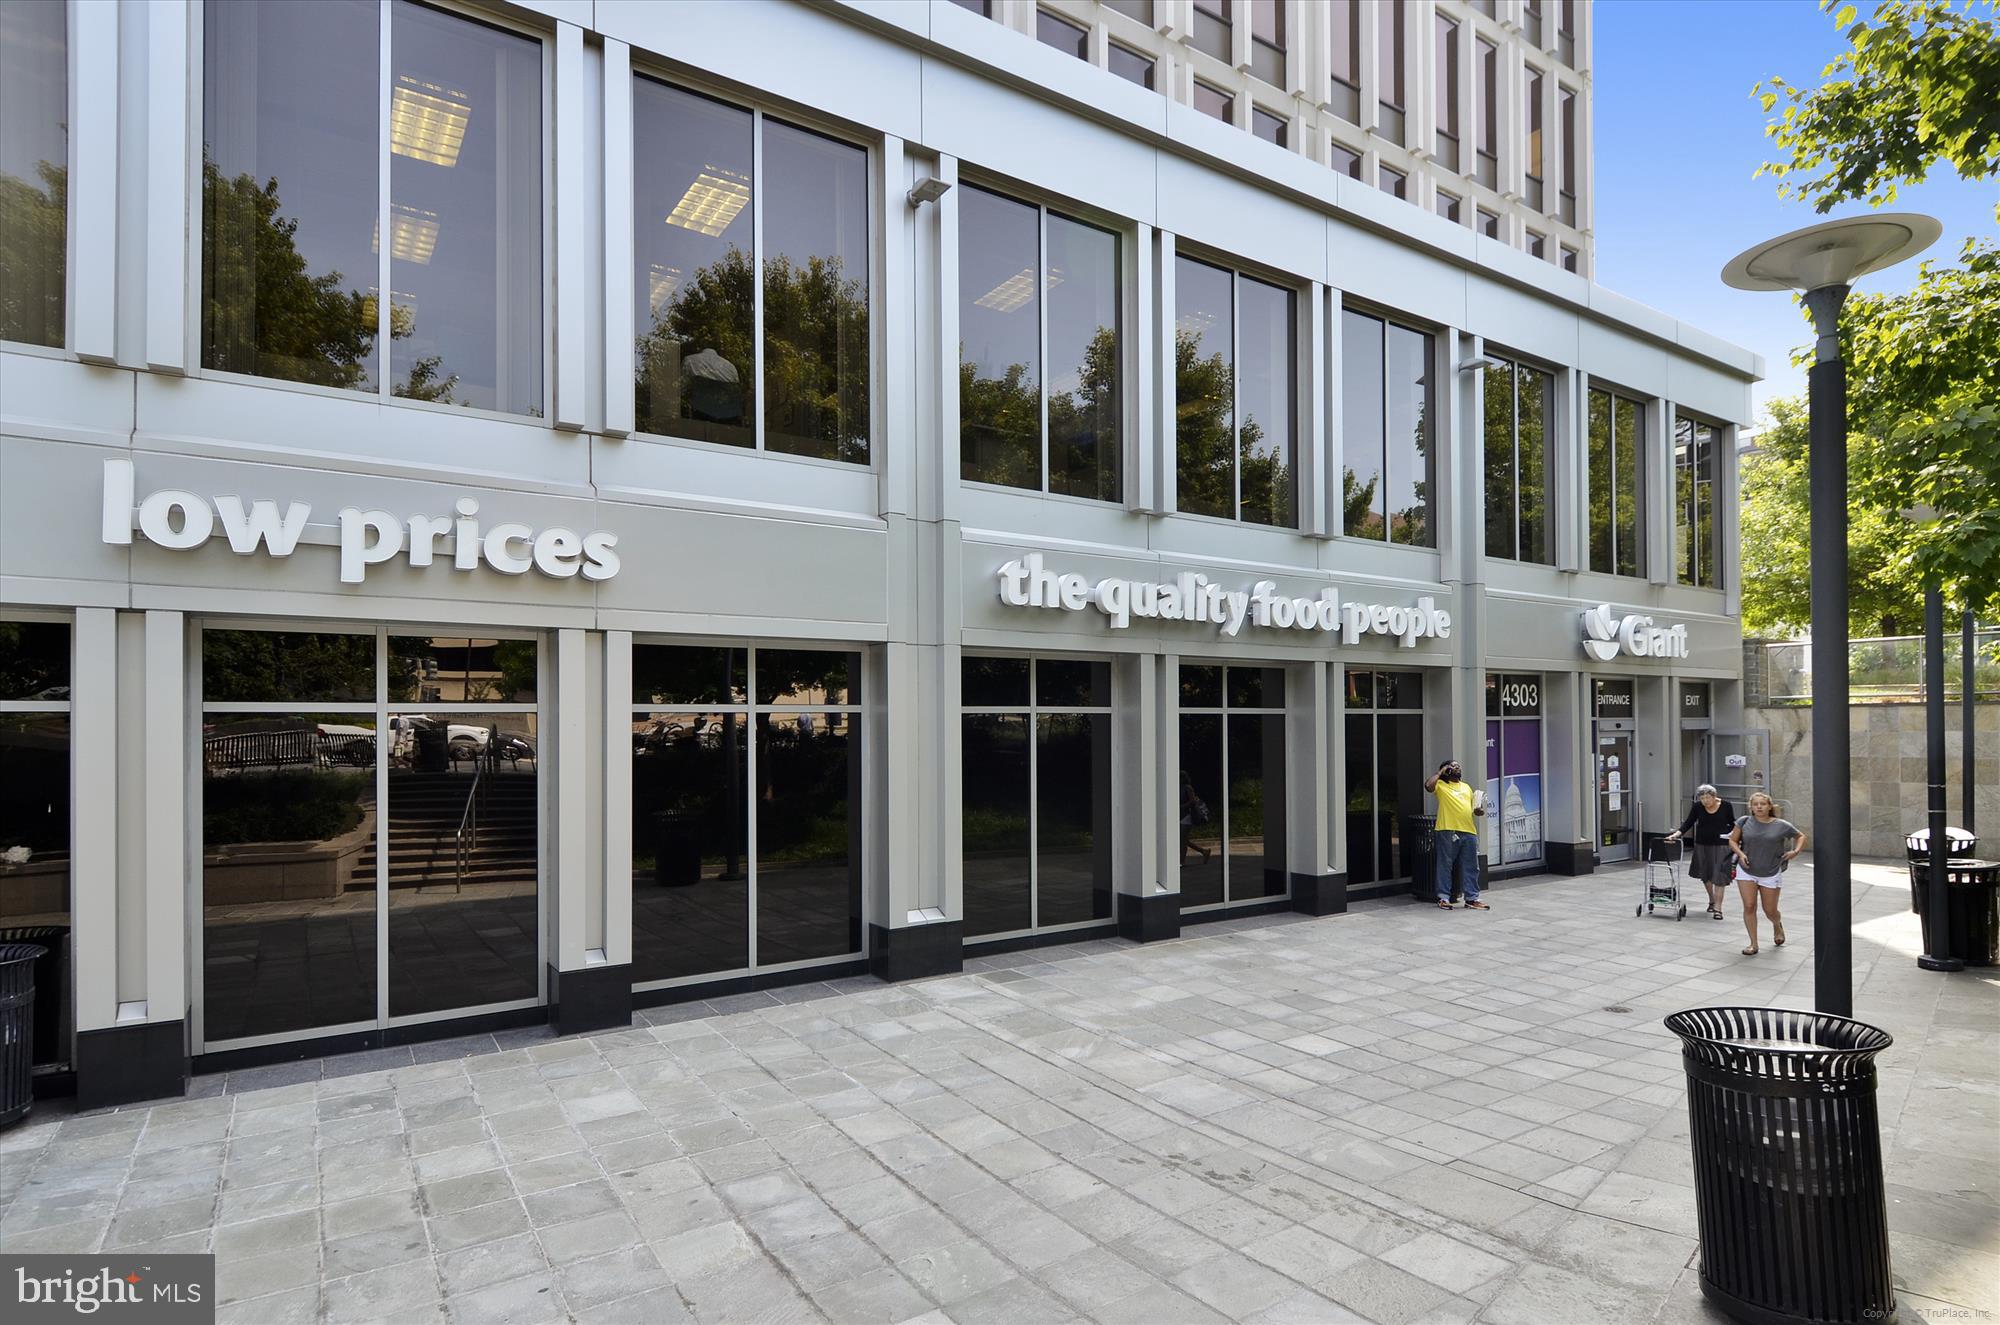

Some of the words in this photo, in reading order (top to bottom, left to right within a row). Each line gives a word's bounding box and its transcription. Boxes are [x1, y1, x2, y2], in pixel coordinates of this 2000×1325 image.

[102, 457, 313, 558] low
[338, 496, 622, 584] prices
[997, 552, 1090, 611] the
[1095, 571, 1250, 637] quality
[1251, 579, 1341, 633] food
[1343, 596, 1452, 648] people
[1619, 614, 1689, 660] Giant
[1502, 683, 1538, 707] 4303
[1597, 694, 1631, 706] ENTRANCE
[1685, 694, 1701, 706] EXIT
